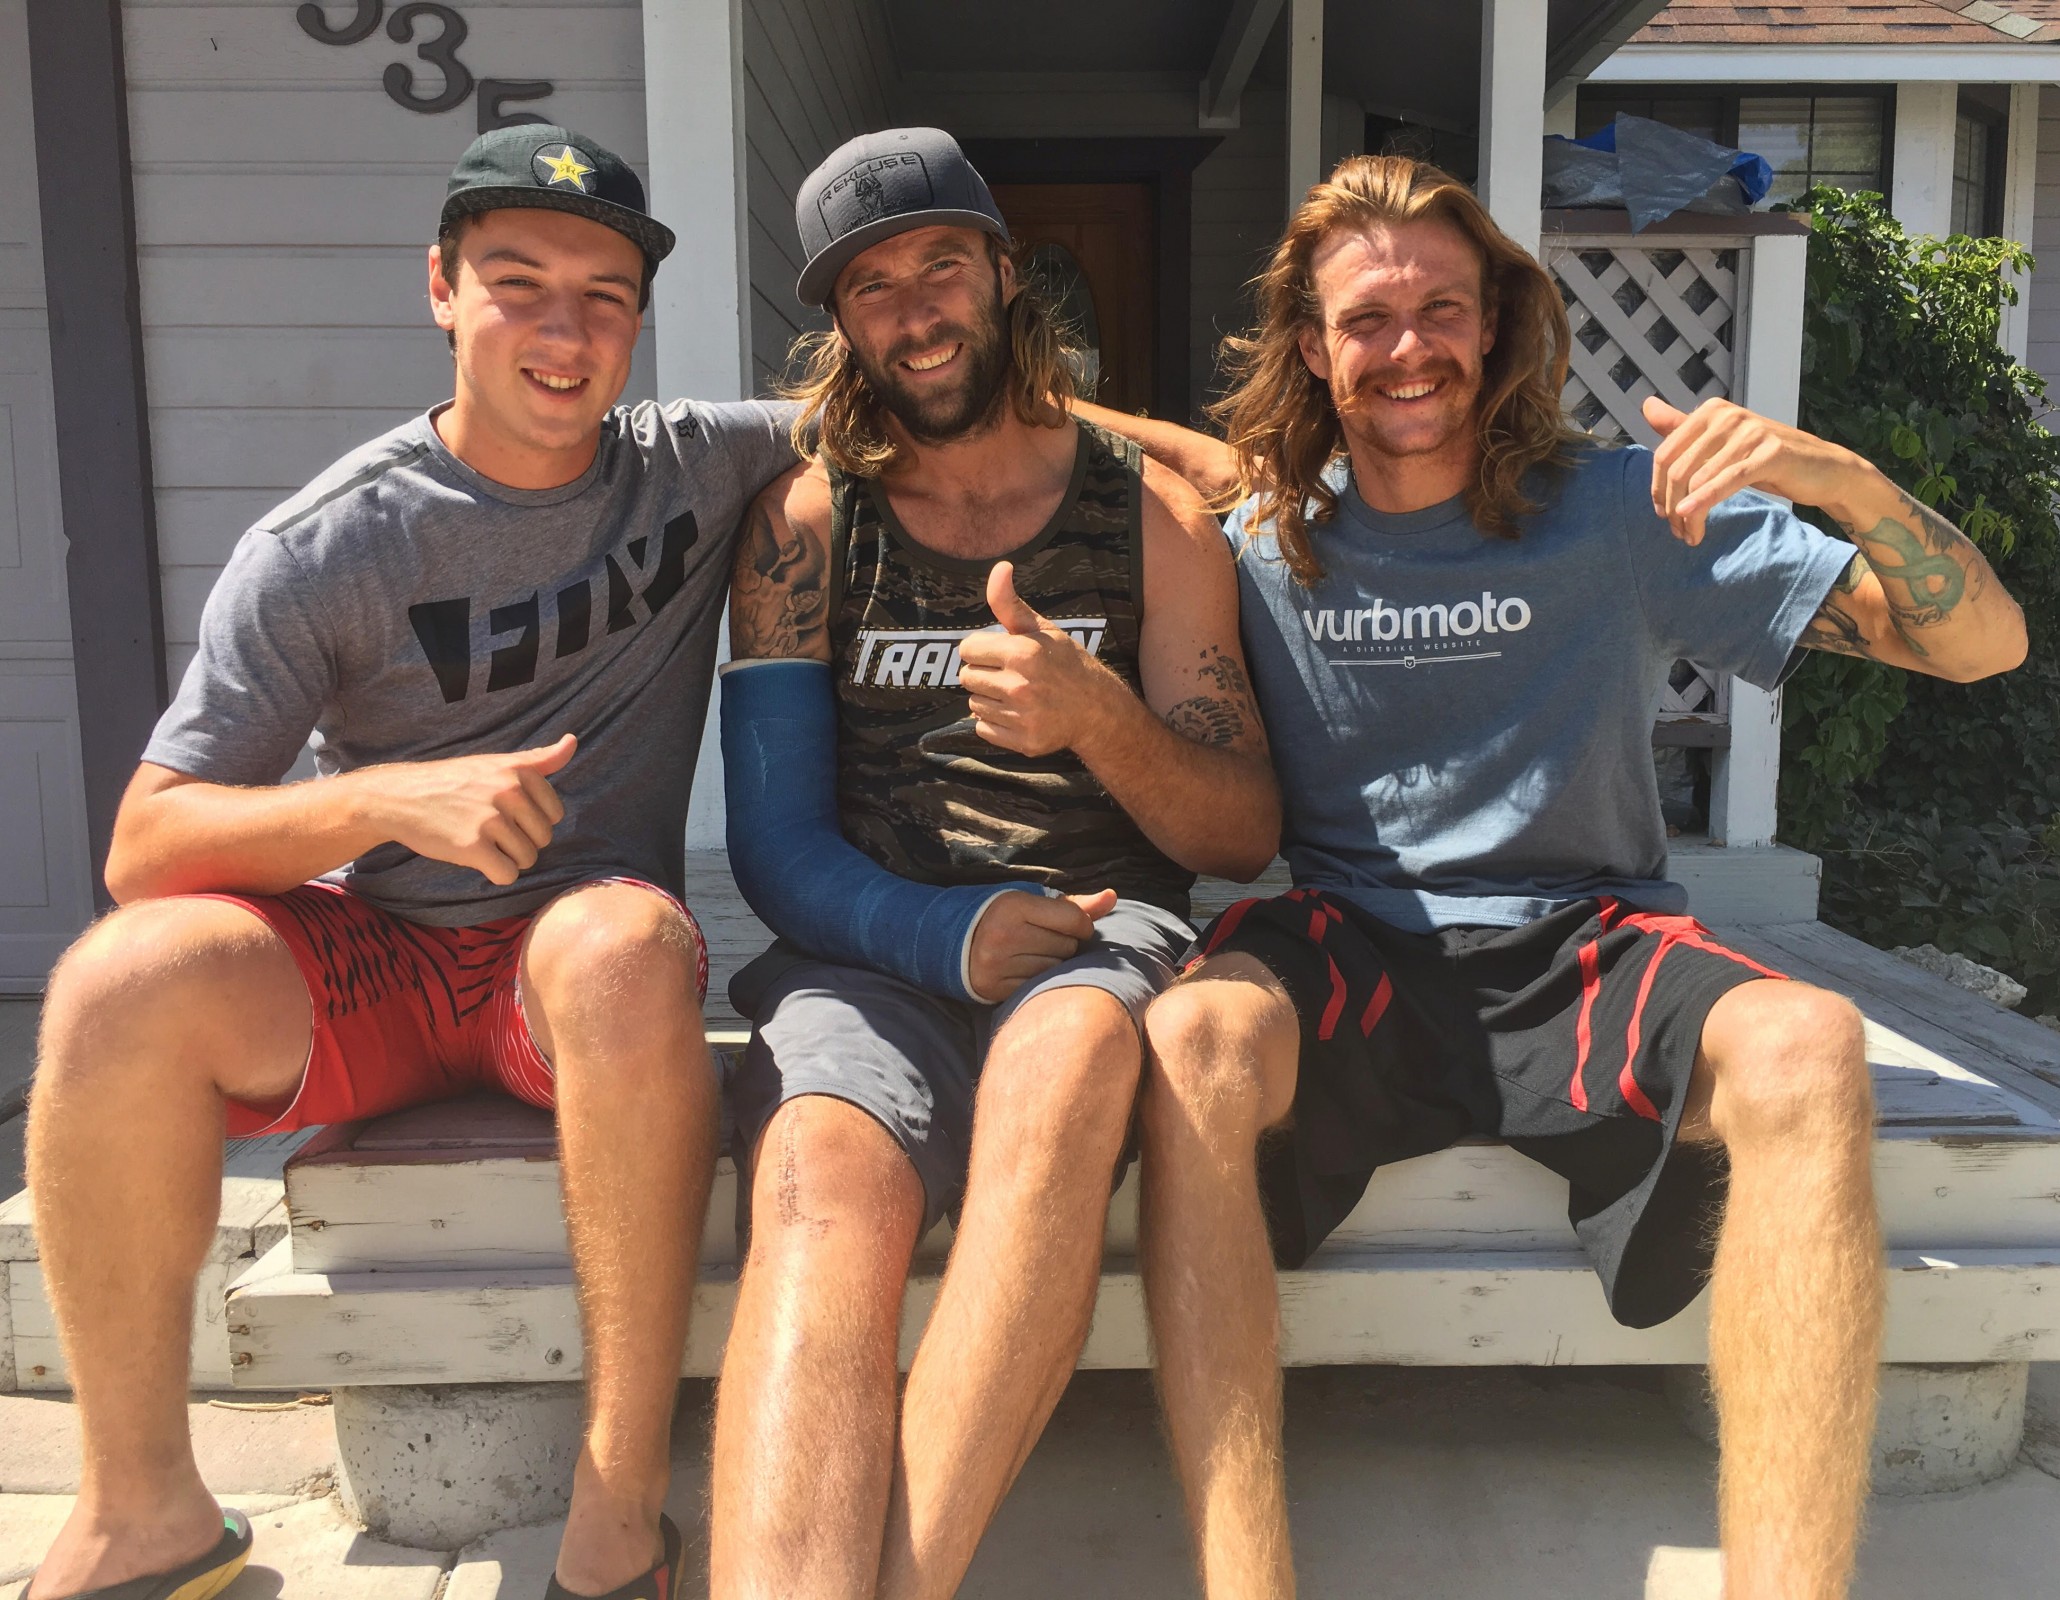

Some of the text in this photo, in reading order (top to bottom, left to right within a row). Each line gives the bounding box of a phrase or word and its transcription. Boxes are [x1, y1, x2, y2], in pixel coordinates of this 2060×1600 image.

[821, 155, 917, 207] REKLUSE
[1303, 591, 1532, 642] vurbmoto
[1356, 645, 1413, 653] DIRTBIKE
[1423, 640, 1481, 650] WEBSITE
